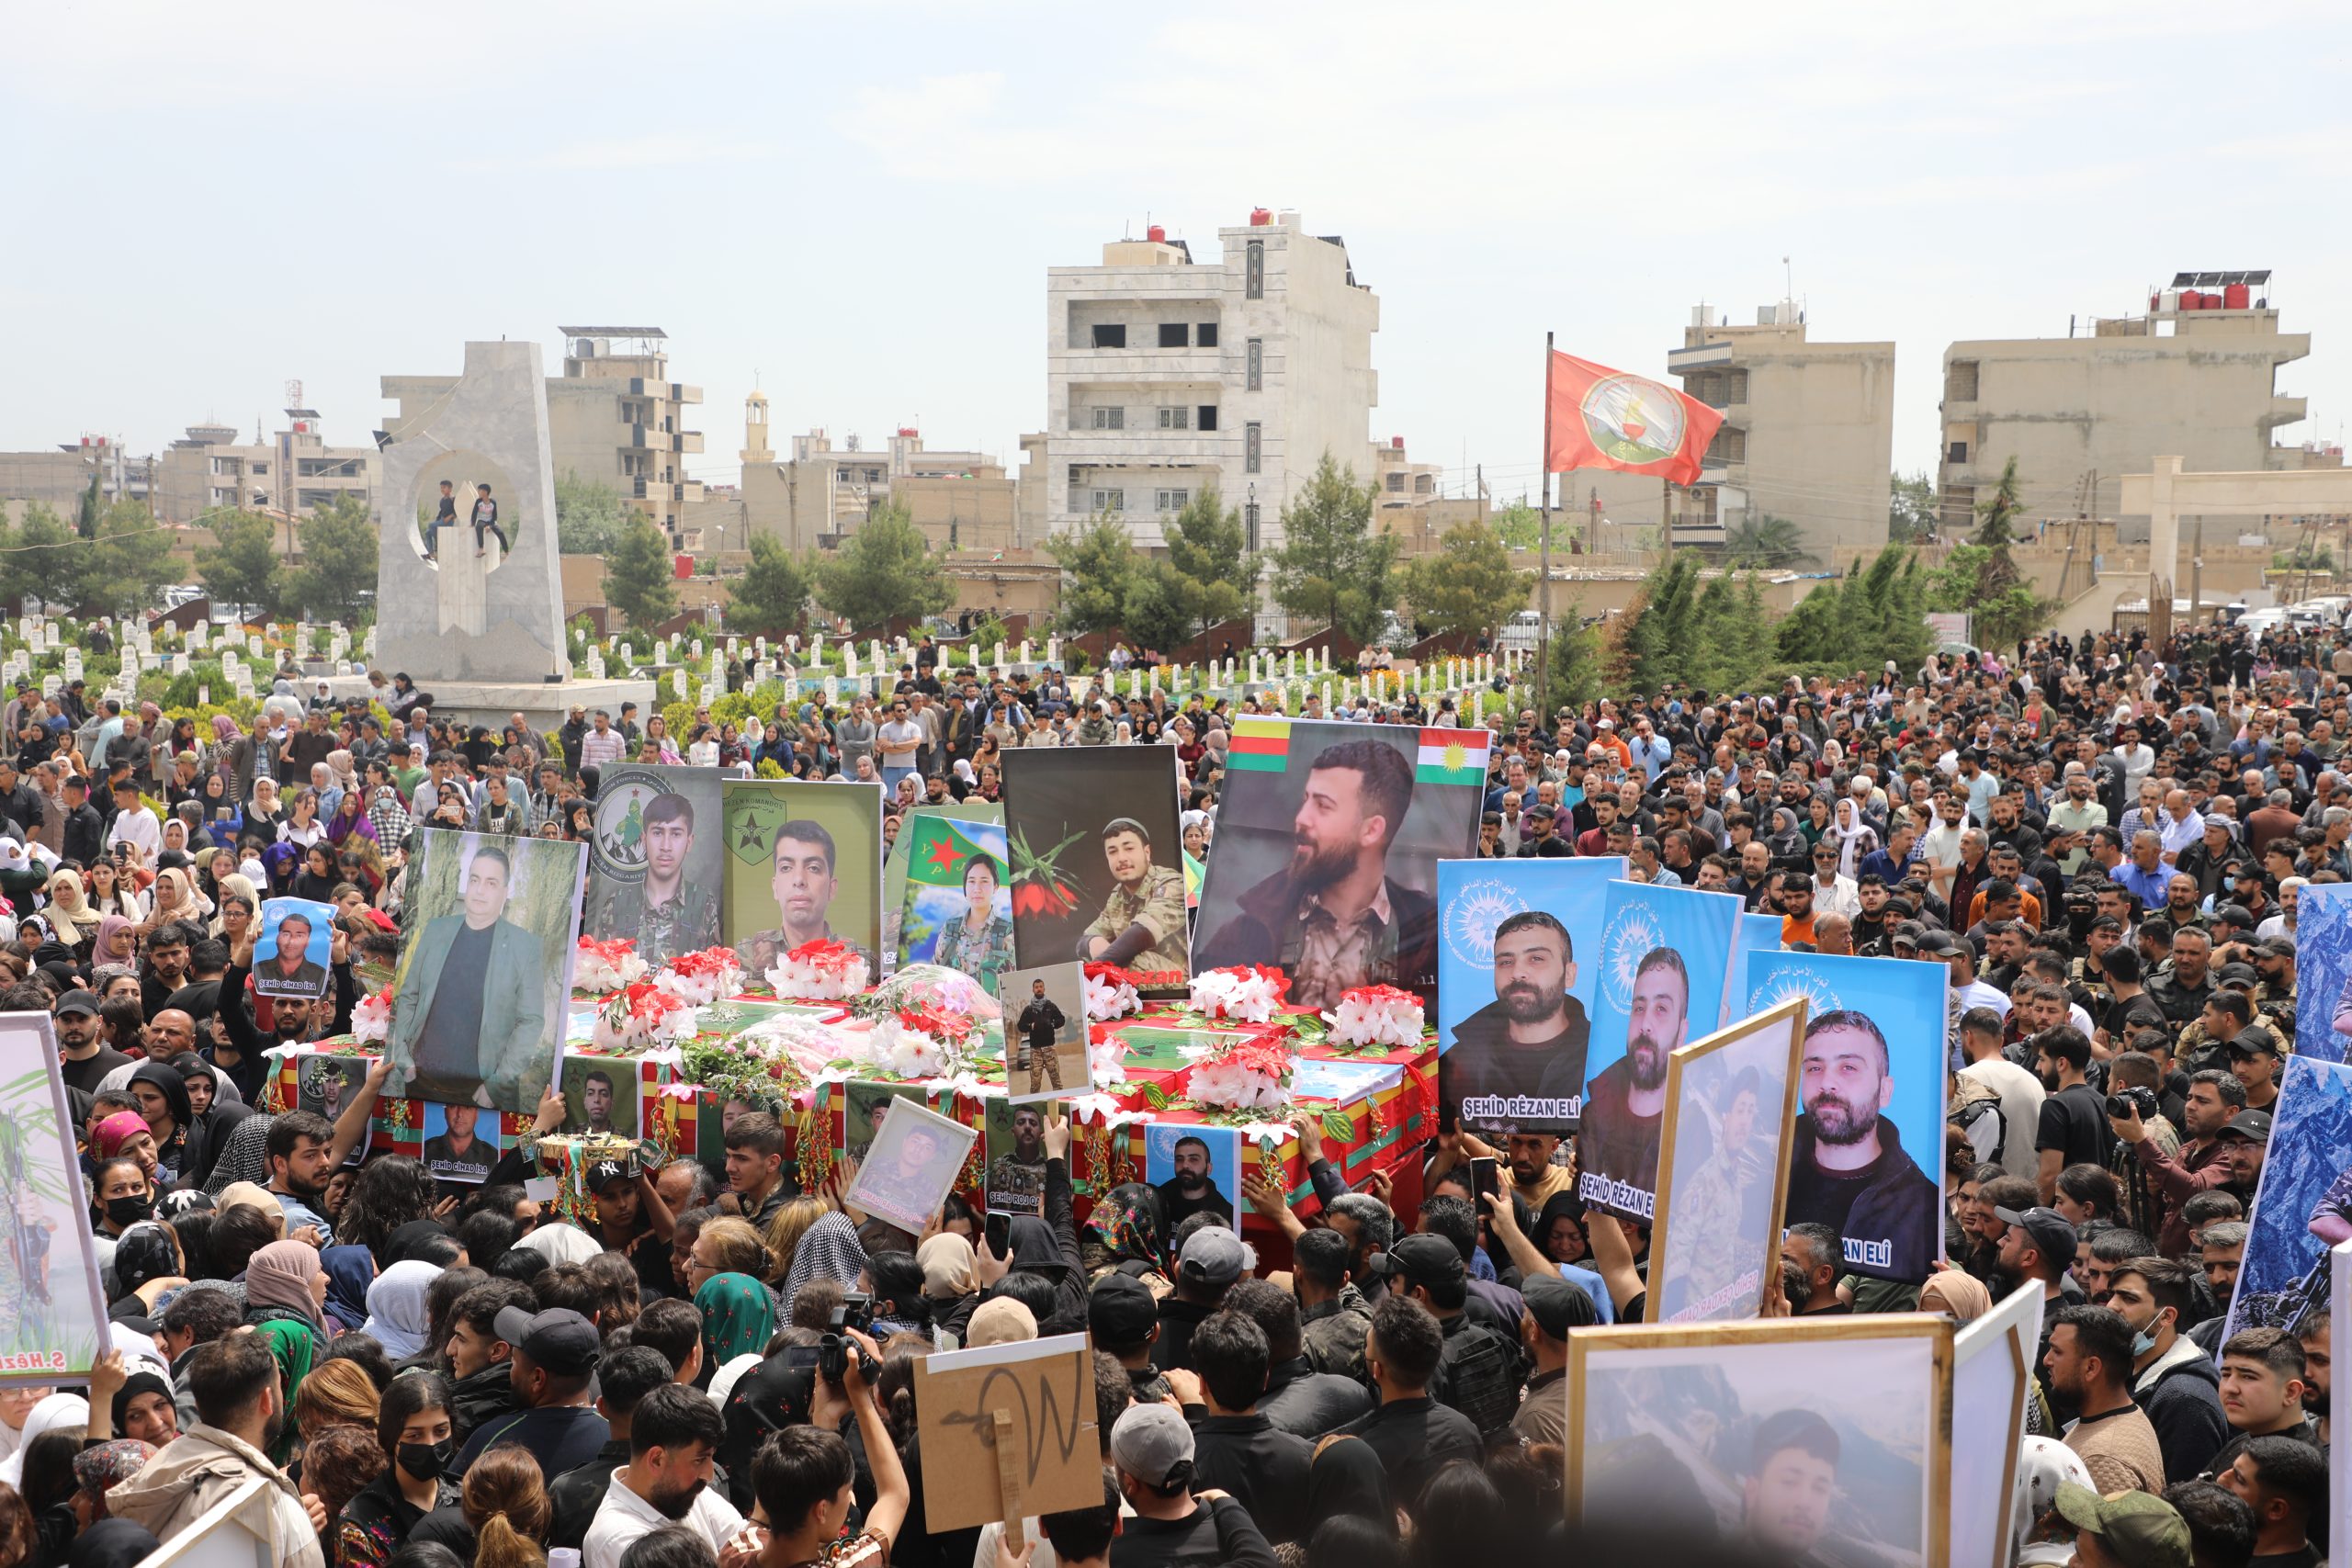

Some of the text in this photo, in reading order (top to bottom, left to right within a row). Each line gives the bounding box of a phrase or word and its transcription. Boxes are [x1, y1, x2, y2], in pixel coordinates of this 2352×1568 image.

[1128, 969, 1183, 986] ozan
[1464, 1095, 1579, 1120] ŞEHÎD RÊZAN ELÎ
[1580, 1173, 1611, 1201] ŞEHÎD
[1611, 1180, 1645, 1214] RÊZAN
[1865, 1240, 1890, 1266] ELÎ
